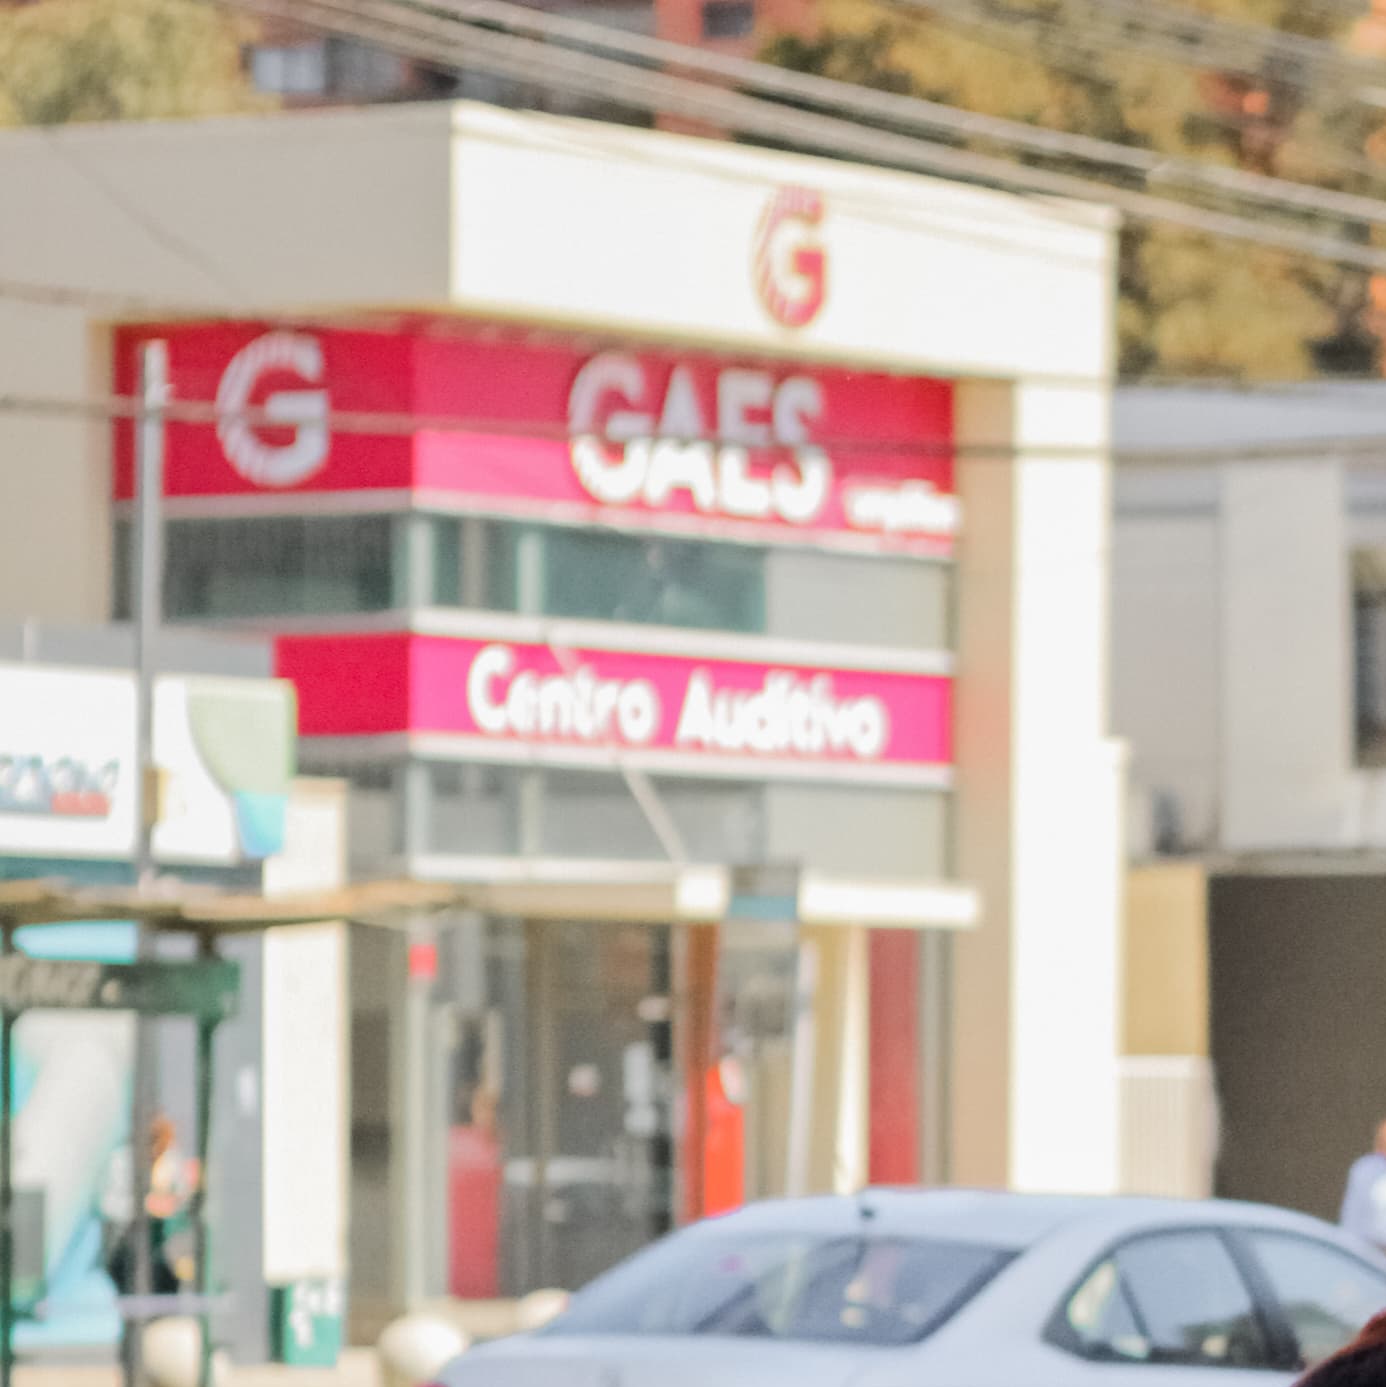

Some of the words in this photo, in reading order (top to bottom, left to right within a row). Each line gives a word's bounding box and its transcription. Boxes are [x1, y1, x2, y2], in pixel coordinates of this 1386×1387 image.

[755, 184, 828, 328] G
[216, 330, 331, 486] G
[568, 349, 832, 525] GAES
[467, 643, 661, 743] Centro
[675, 667, 889, 758] Auditivo
